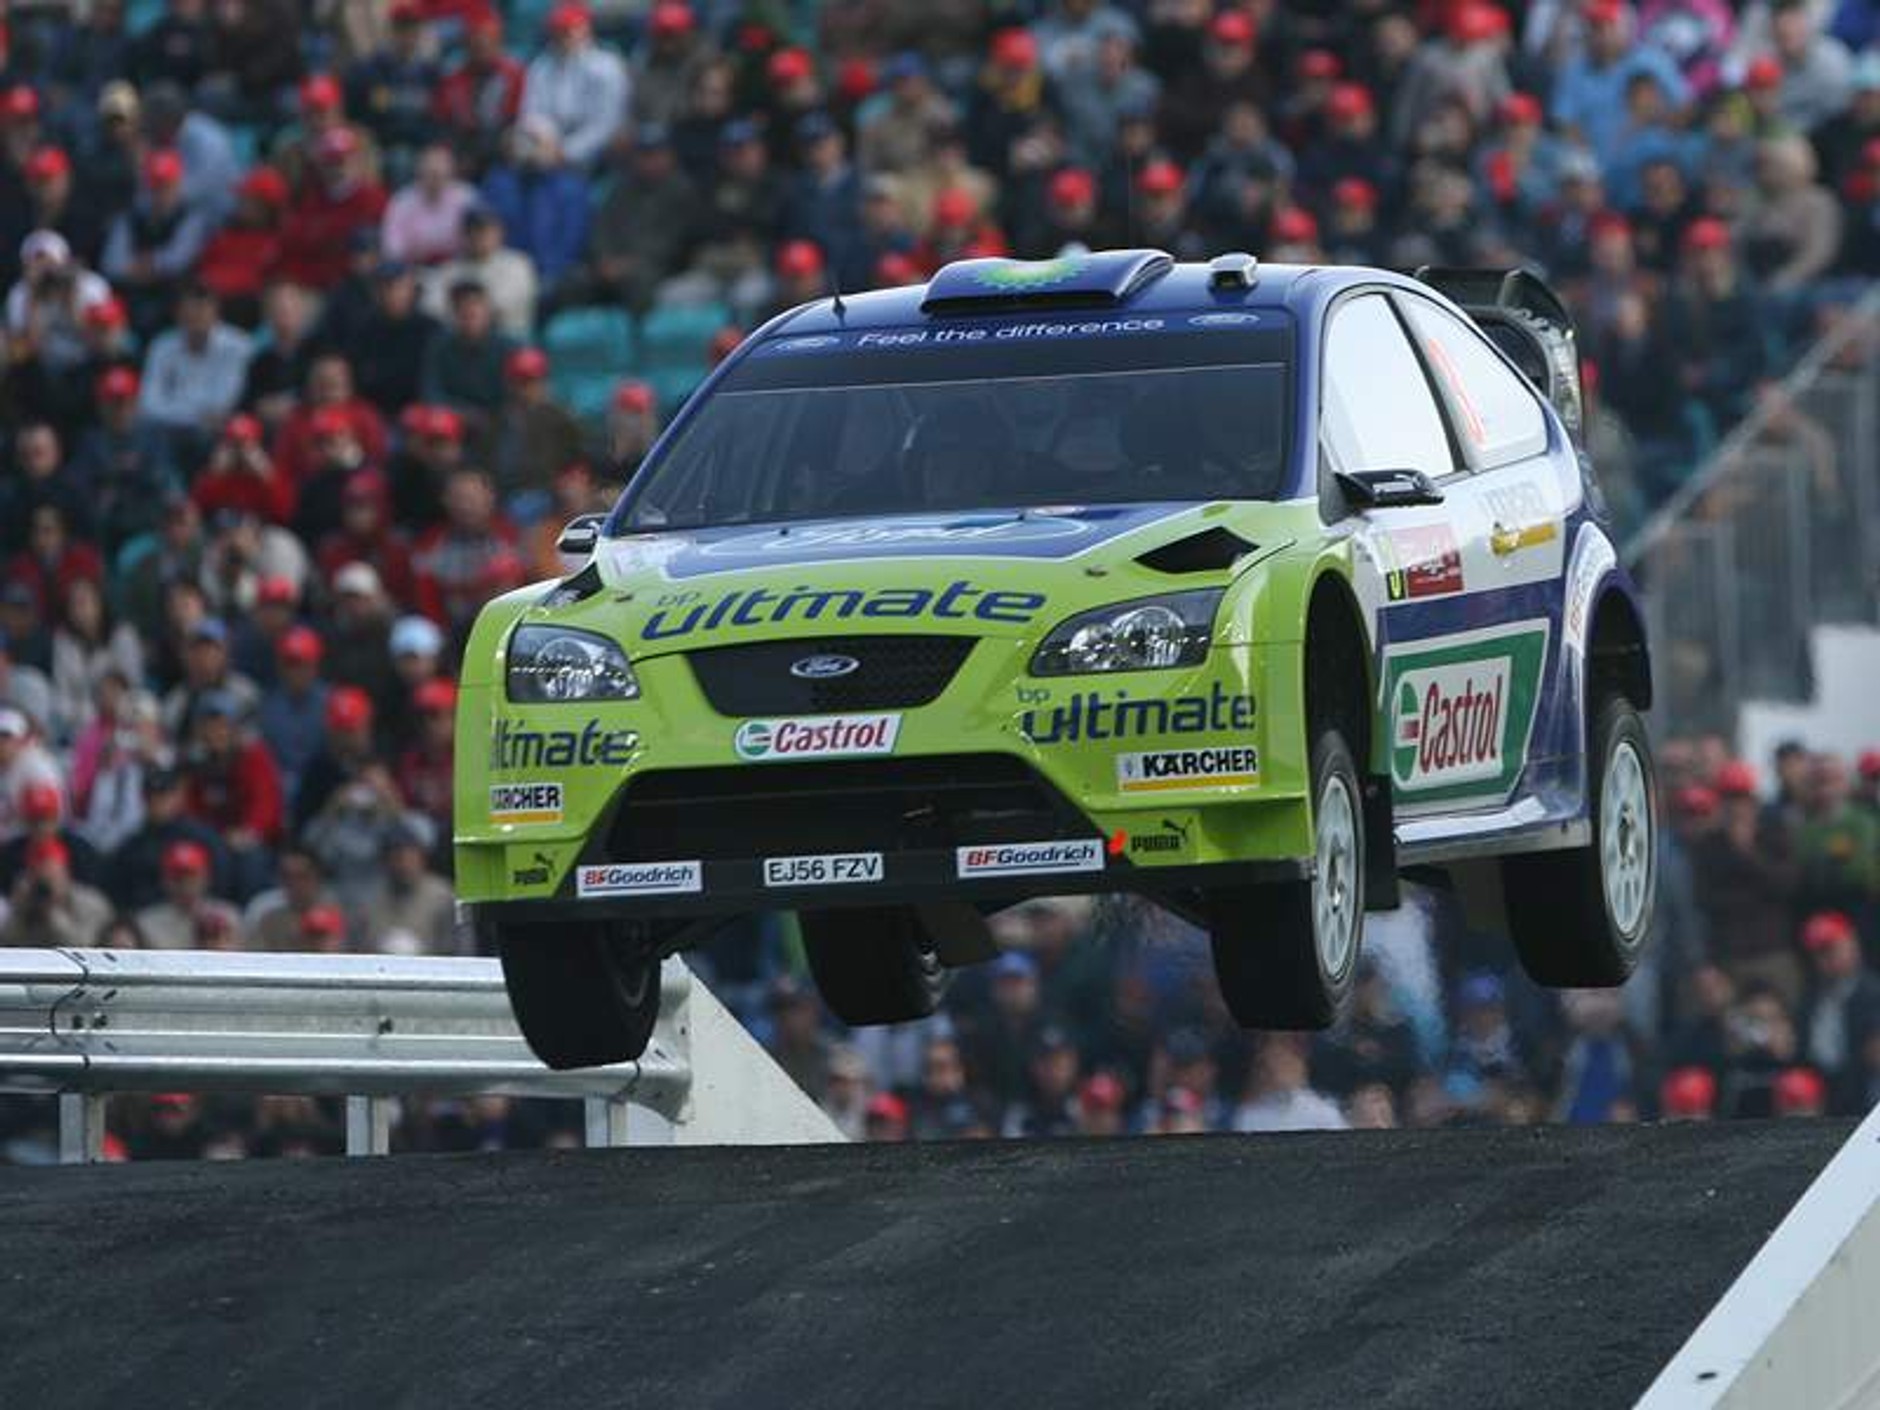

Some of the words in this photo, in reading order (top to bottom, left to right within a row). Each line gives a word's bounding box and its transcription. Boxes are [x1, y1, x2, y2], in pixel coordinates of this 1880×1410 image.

[857, 331, 926, 346] Feel
[935, 329, 986, 342] the
[996, 319, 1165, 339] difference
[641, 580, 1047, 640] ultimate
[1017, 686, 1050, 703] bp
[1022, 680, 1257, 744] ultimate
[1420, 673, 1502, 774] Castrol
[491, 718, 641, 770] ltimate
[775, 717, 888, 753] Castrol
[1142, 749, 1257, 778] KÄRCHER
[769, 858, 826, 883] EJ56
[832, 856, 879, 880] FZV
[966, 844, 1095, 867] BFGoodrich
[584, 865, 693, 886] BFGoodrich
